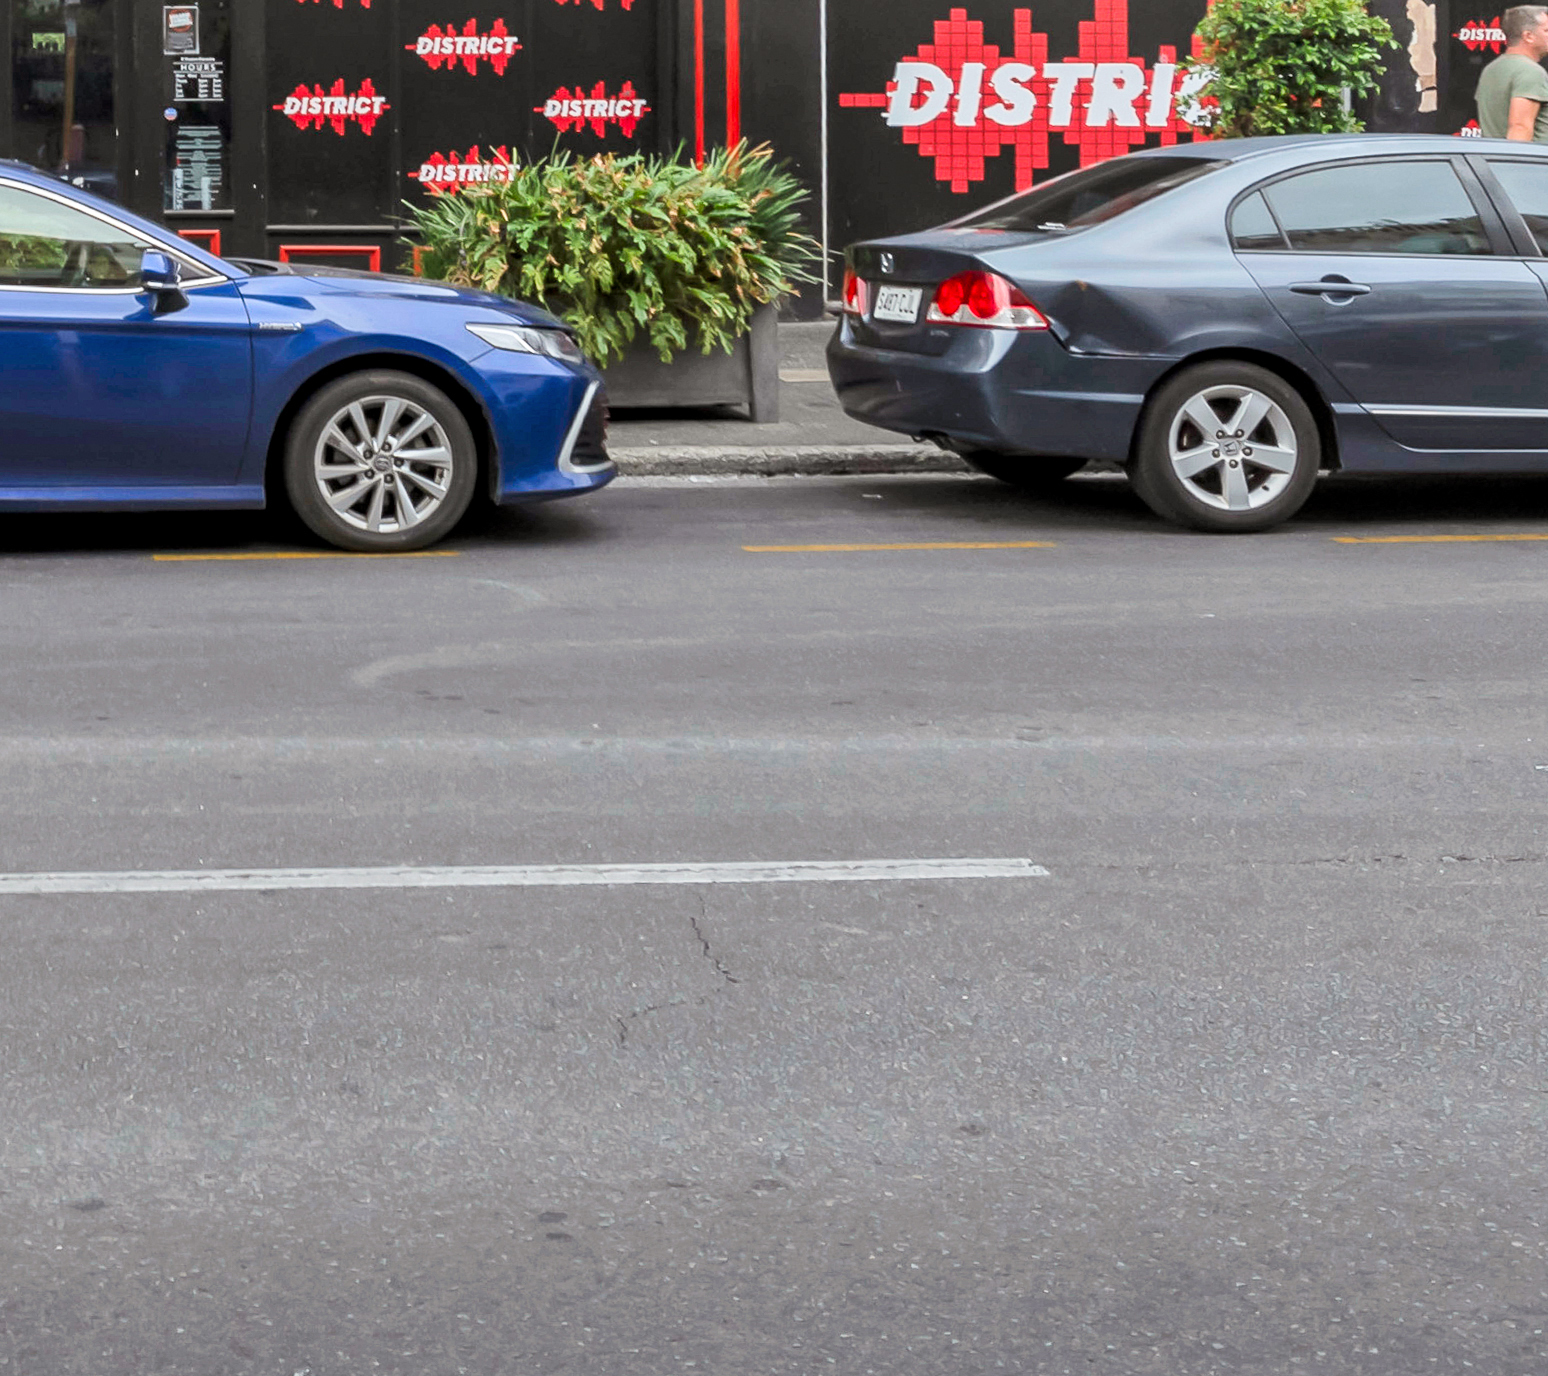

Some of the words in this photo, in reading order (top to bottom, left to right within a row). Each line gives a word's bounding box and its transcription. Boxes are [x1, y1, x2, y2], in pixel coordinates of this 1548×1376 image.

[416, 36, 519, 56] DISTRICT
[180, 63, 216, 72] HOURS
[283, 96, 386, 116] DISTRICT
[543, 98, 647, 118] DISTRICT
